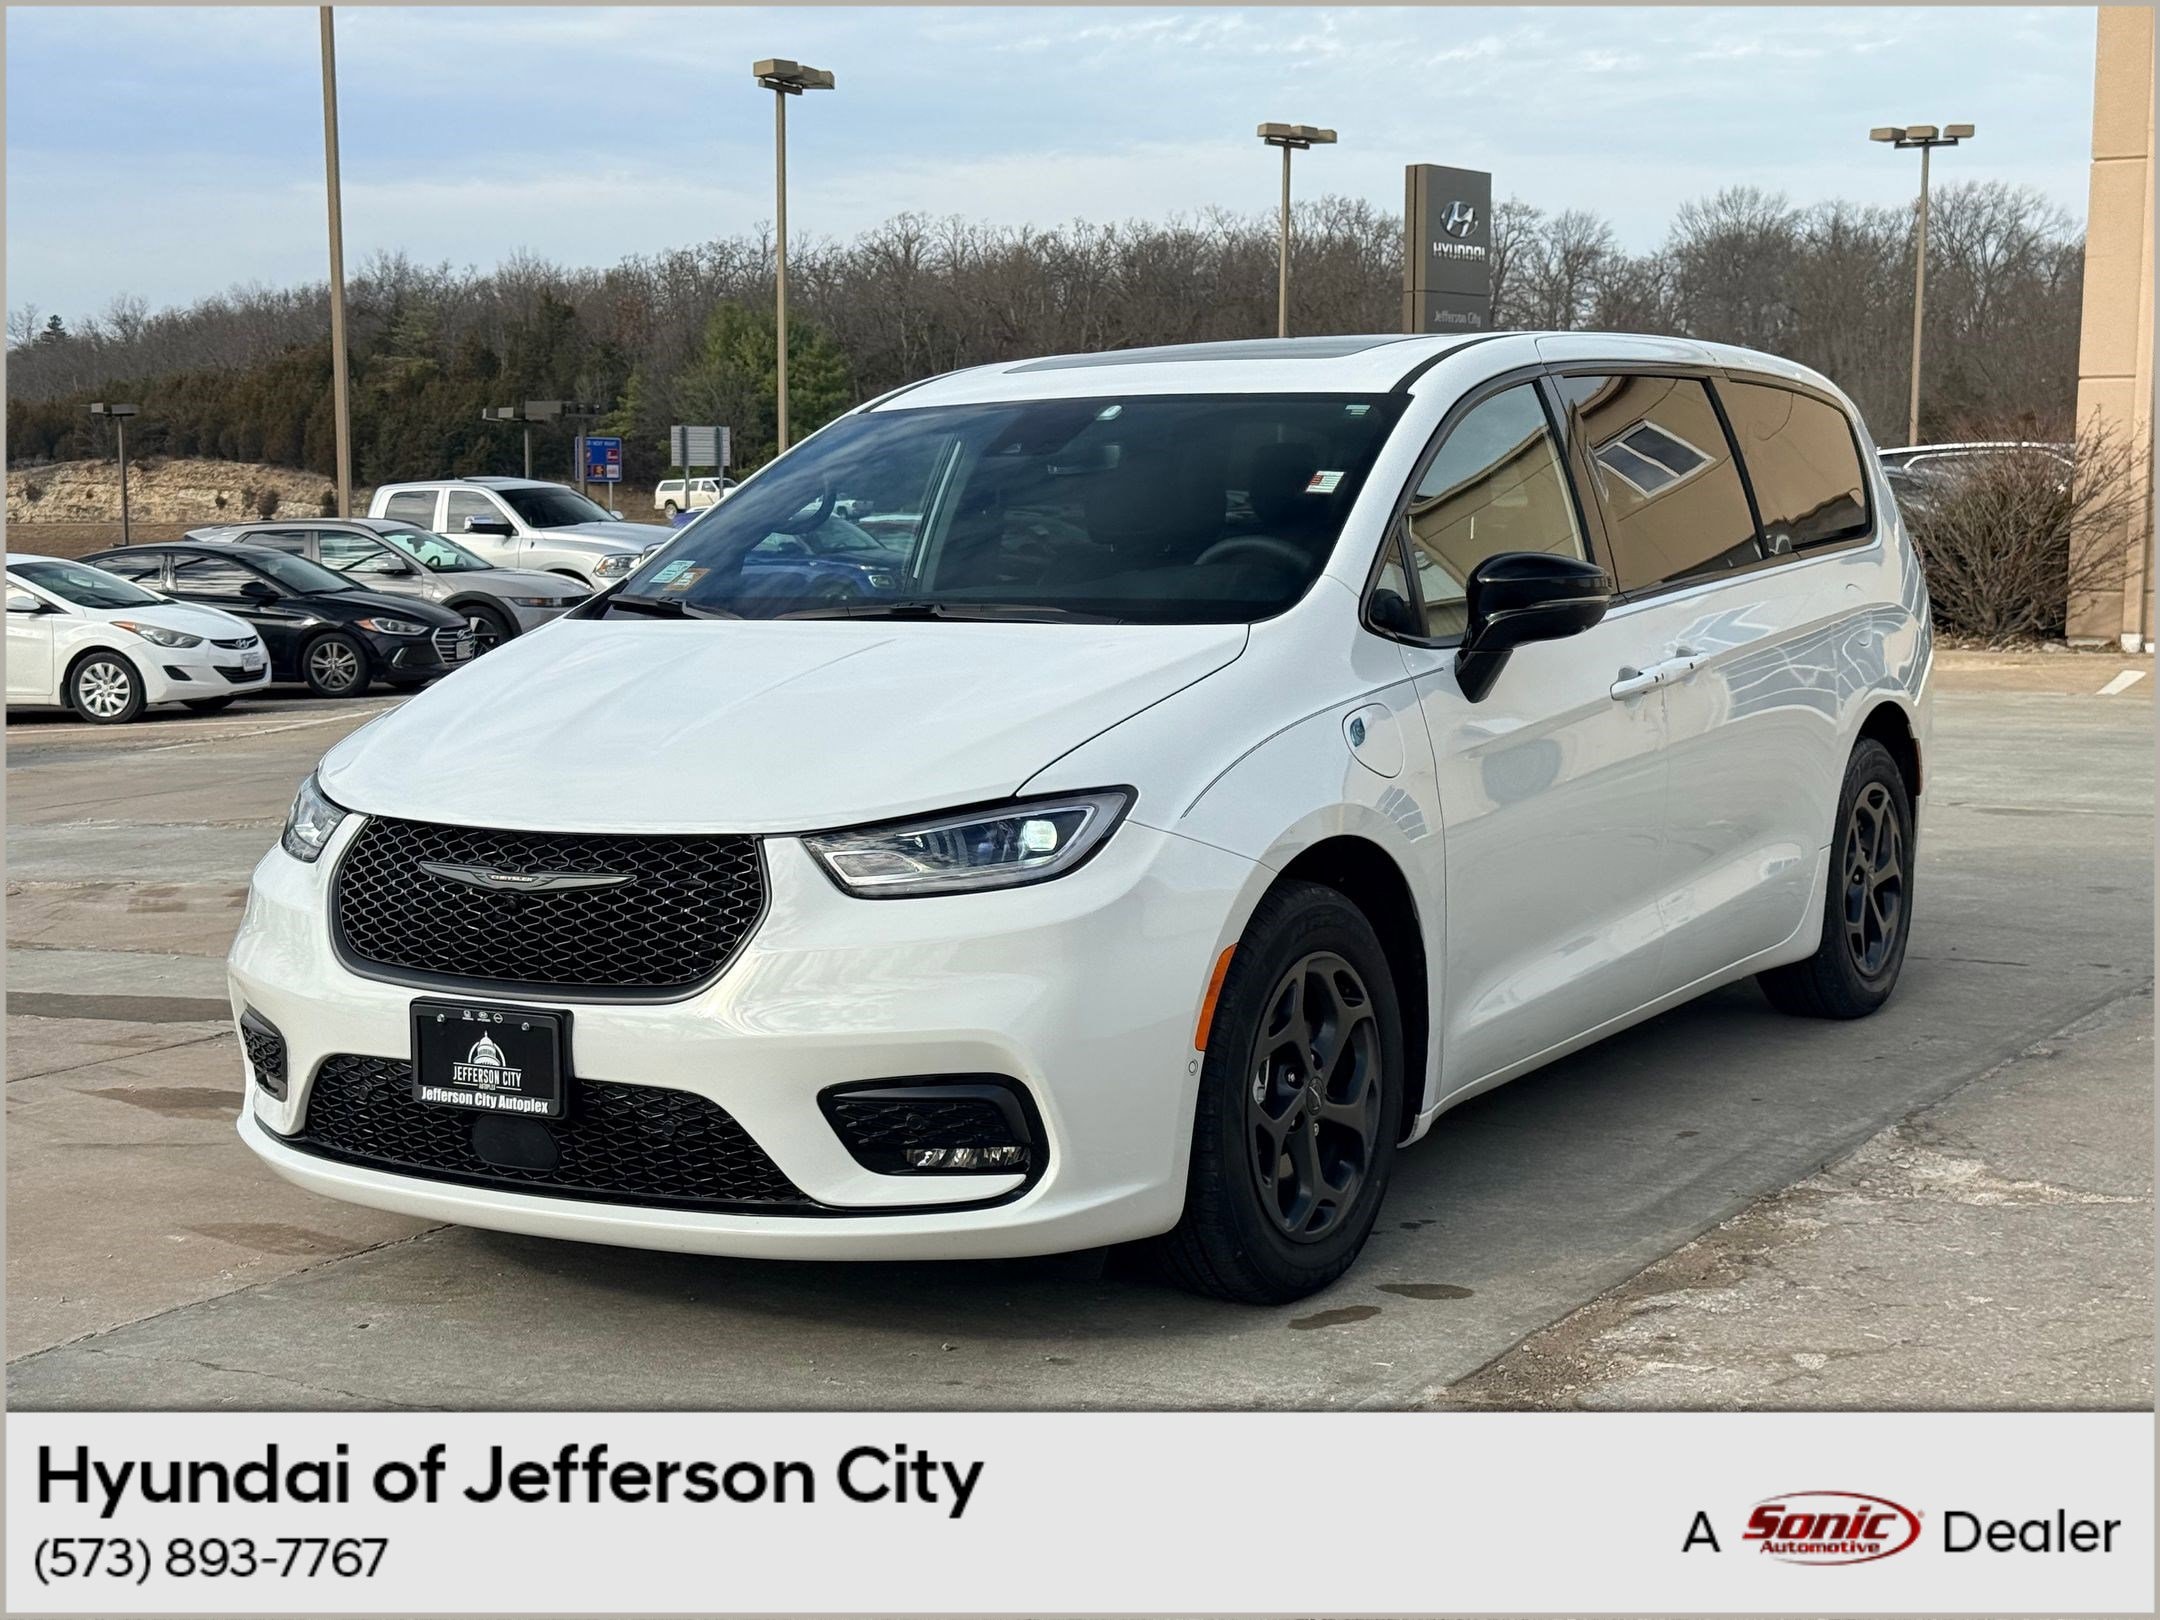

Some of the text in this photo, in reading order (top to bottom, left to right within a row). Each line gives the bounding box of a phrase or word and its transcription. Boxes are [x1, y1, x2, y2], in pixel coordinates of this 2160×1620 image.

[1432, 241, 1486, 260] HYUNDAI
[1434, 310, 1481, 328] Jefferson City
[453, 1065, 522, 1087] JEFFERSON CITY
[421, 1086, 549, 1114] Jefferson City Autoplex
